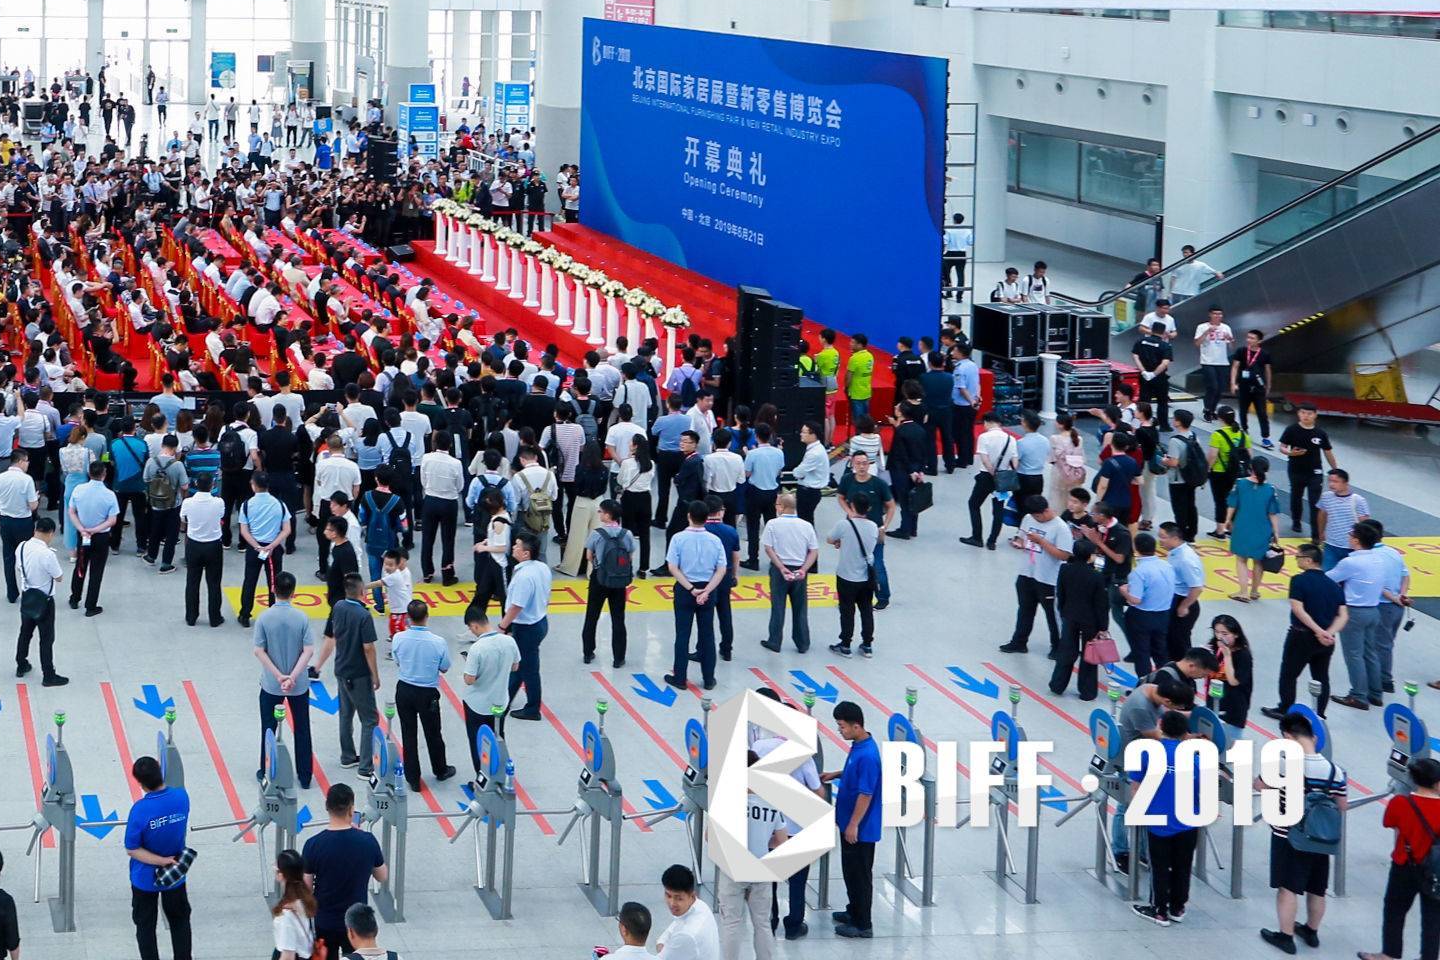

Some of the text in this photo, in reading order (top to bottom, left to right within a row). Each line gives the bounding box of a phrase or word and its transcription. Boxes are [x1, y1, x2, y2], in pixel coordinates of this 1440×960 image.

[632, 65, 843, 129] 北京国际家居展暨新零售博览会
[684, 136, 766, 186] 开幕典礼
[683, 172, 763, 208] Opening Ceremony
[714, 218, 764, 246] 2019年6月21日
[376, 800, 389, 810] 125
[747, 805, 784, 822] OTT
[150, 816, 168, 830] BIFF
